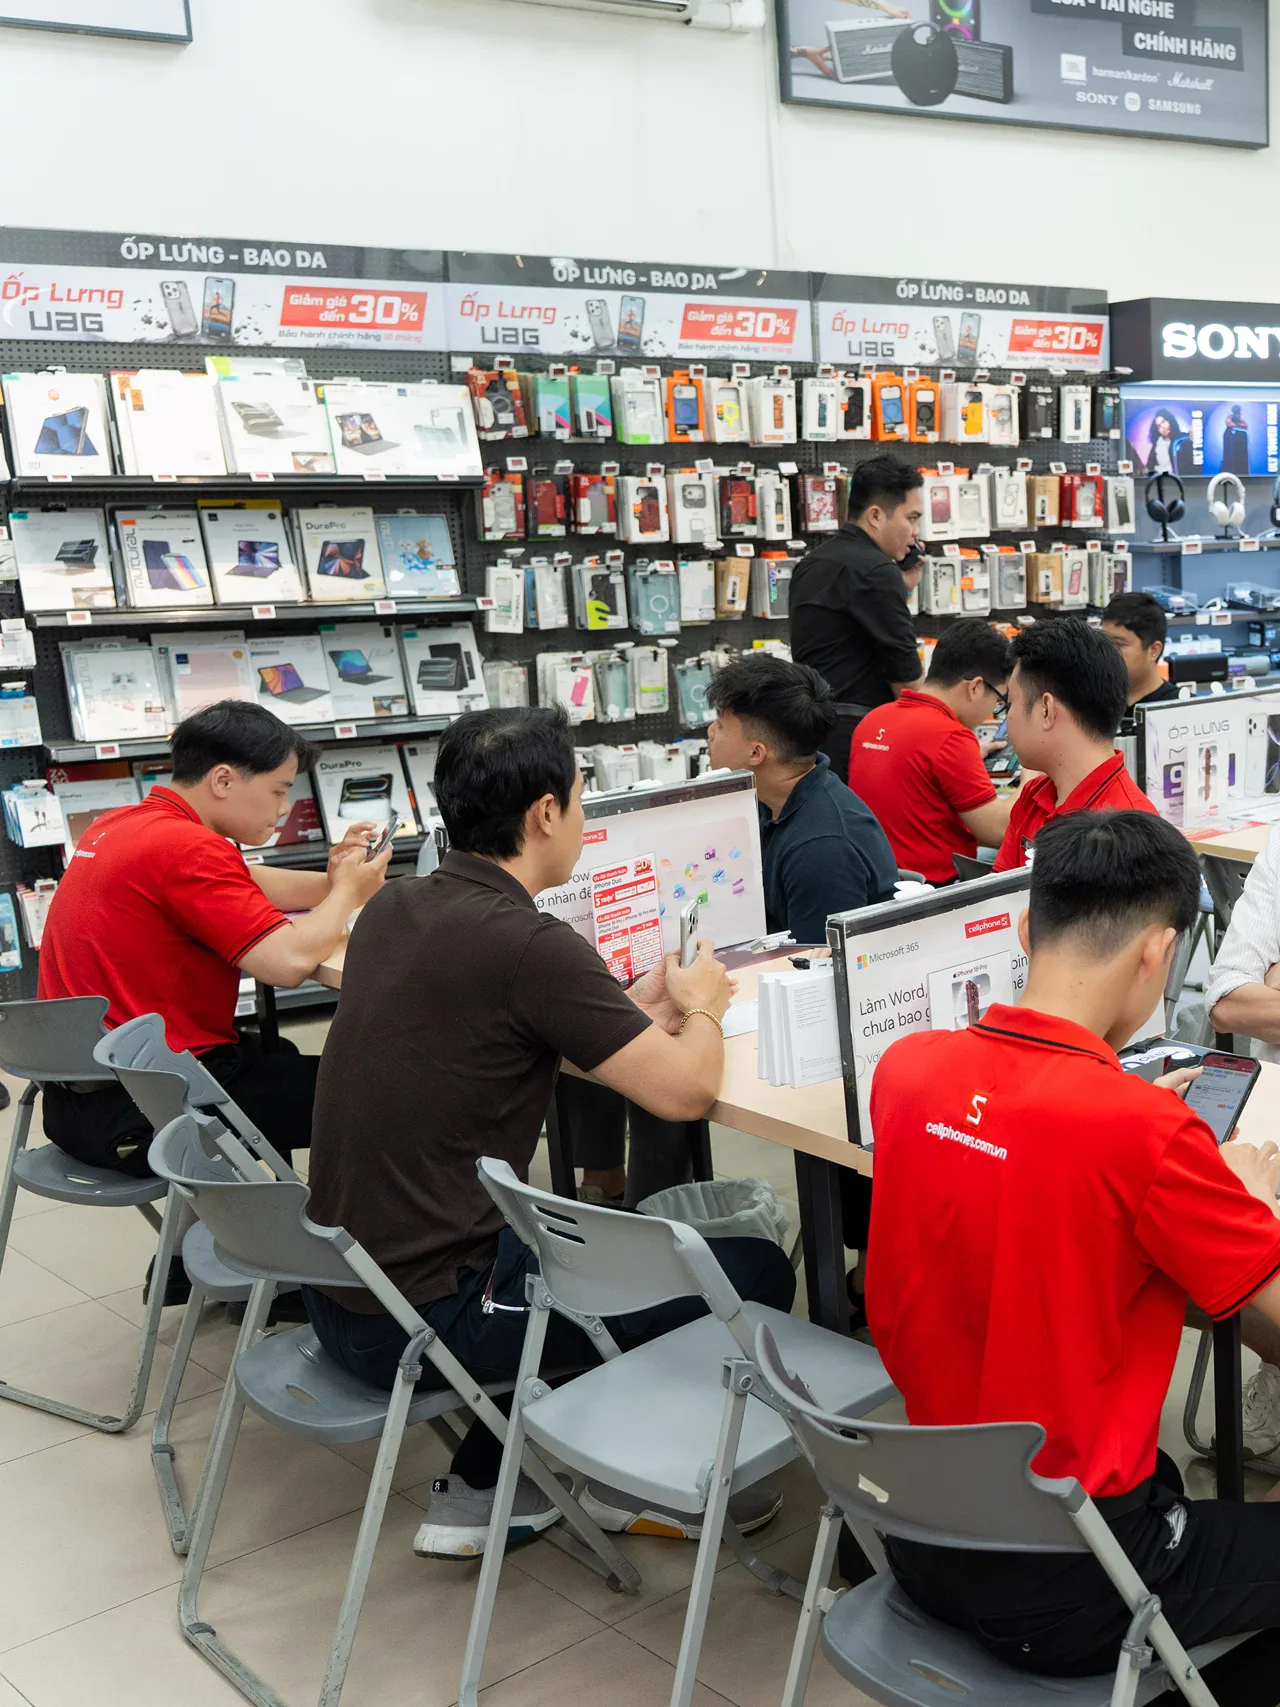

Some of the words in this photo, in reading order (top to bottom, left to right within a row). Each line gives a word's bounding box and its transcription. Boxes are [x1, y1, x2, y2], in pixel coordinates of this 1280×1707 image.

[1128, 0, 1175, 19] NGHE
[1133, 31, 1188, 55] CHÍNH
[1190, 37, 1237, 61] HÃNG
[1167, 71, 1214, 91] Marshall
[1076, 91, 1119, 105] SONY
[1148, 98, 1202, 115] SAMSUNG
[120, 236, 154, 260] ỐP
[159, 242, 225, 264] LƯNG
[243, 248, 292, 268] BAO
[295, 250, 328, 269] DA
[584, 265, 636, 286] LƯNG
[650, 270, 688, 288] BAO
[691, 272, 718, 290] DA
[289, 293, 324, 306] Giảm
[326, 296, 348, 309] giá
[896, 279, 918, 299] ỐP
[921, 281, 964, 302] LƯNG
[975, 287, 1007, 305] BAO
[1009, 290, 1030, 306] DA
[319, 309, 345, 322] đến
[348, 294, 419, 325] 30%
[687, 310, 716, 322] Giảm
[710, 323, 732, 336] đến
[734, 311, 791, 338] 30%
[1052, 325, 1099, 350] 30%
[319, 760, 363, 771] DuraPro
[594, 881, 611, 889] iPhone
[547, 890, 576, 907] nhàn
[869, 944, 905, 964] Microsoft
[906, 942, 920, 954] 365
[957, 968, 973, 978] iPhone
[980, 964, 988, 972] Pro
[859, 997, 888, 1016] Làm
[888, 983, 928, 1007] Word,
[863, 1017, 895, 1038] chưa
[898, 1010, 923, 1027] bao
[925, 1122, 1008, 1161] cellphones.com.vn
